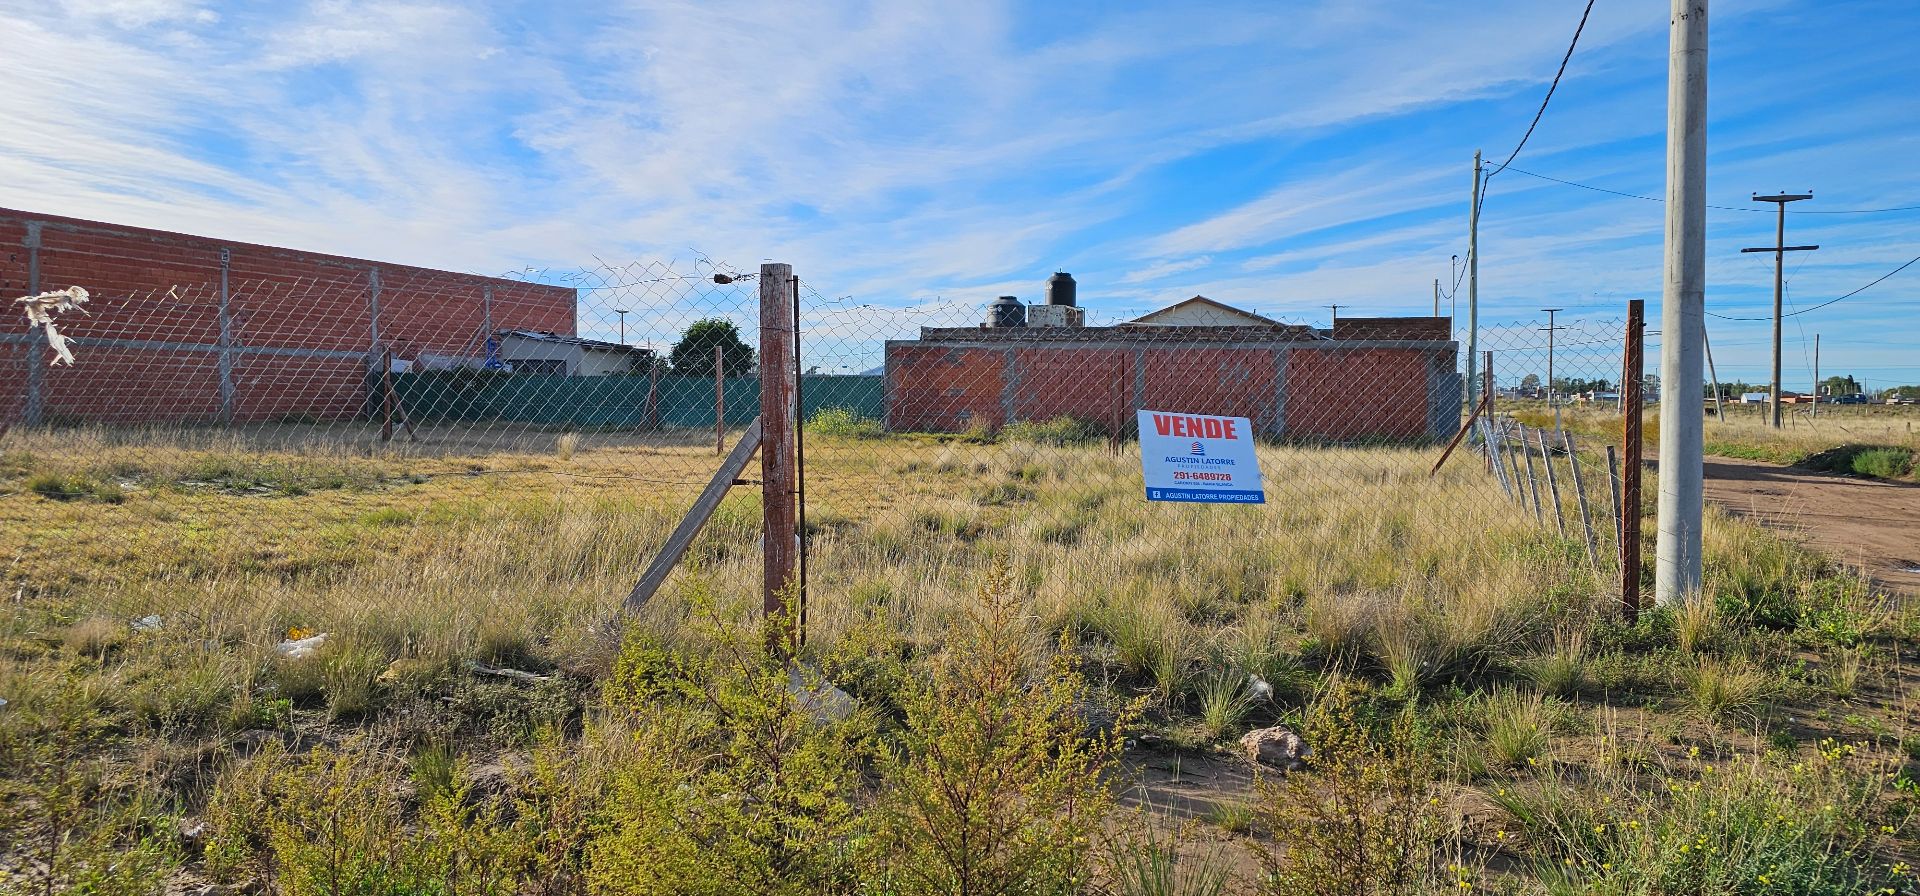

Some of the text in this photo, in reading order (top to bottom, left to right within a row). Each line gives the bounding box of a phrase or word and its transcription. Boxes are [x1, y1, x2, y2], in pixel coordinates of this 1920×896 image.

[1153, 414, 1238, 440] VENDE
[1165, 456, 1236, 466] AGUSTIN LATORRE
[1173, 471, 1232, 481] 291-6489728
